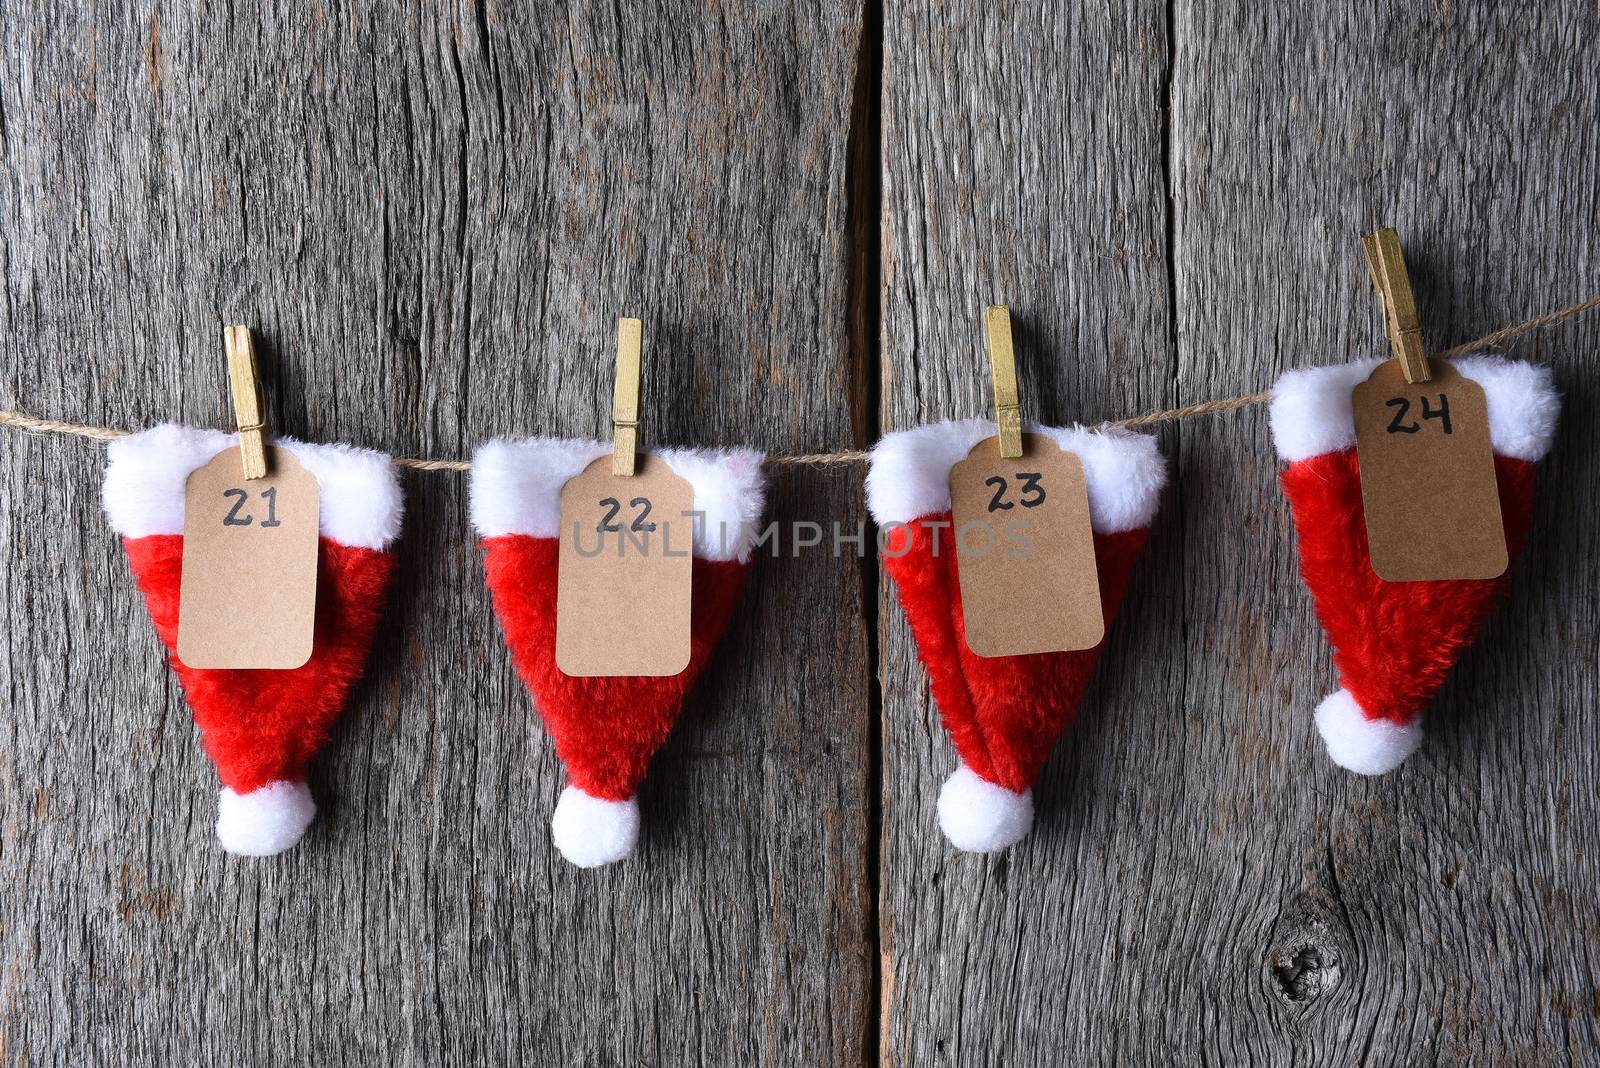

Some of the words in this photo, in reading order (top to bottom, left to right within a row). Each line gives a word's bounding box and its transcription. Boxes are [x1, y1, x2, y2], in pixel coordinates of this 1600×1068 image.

[1386, 394, 1452, 434] 24
[223, 487, 281, 528] 21
[986, 472, 1046, 513] 23
[597, 497, 656, 532] 22
